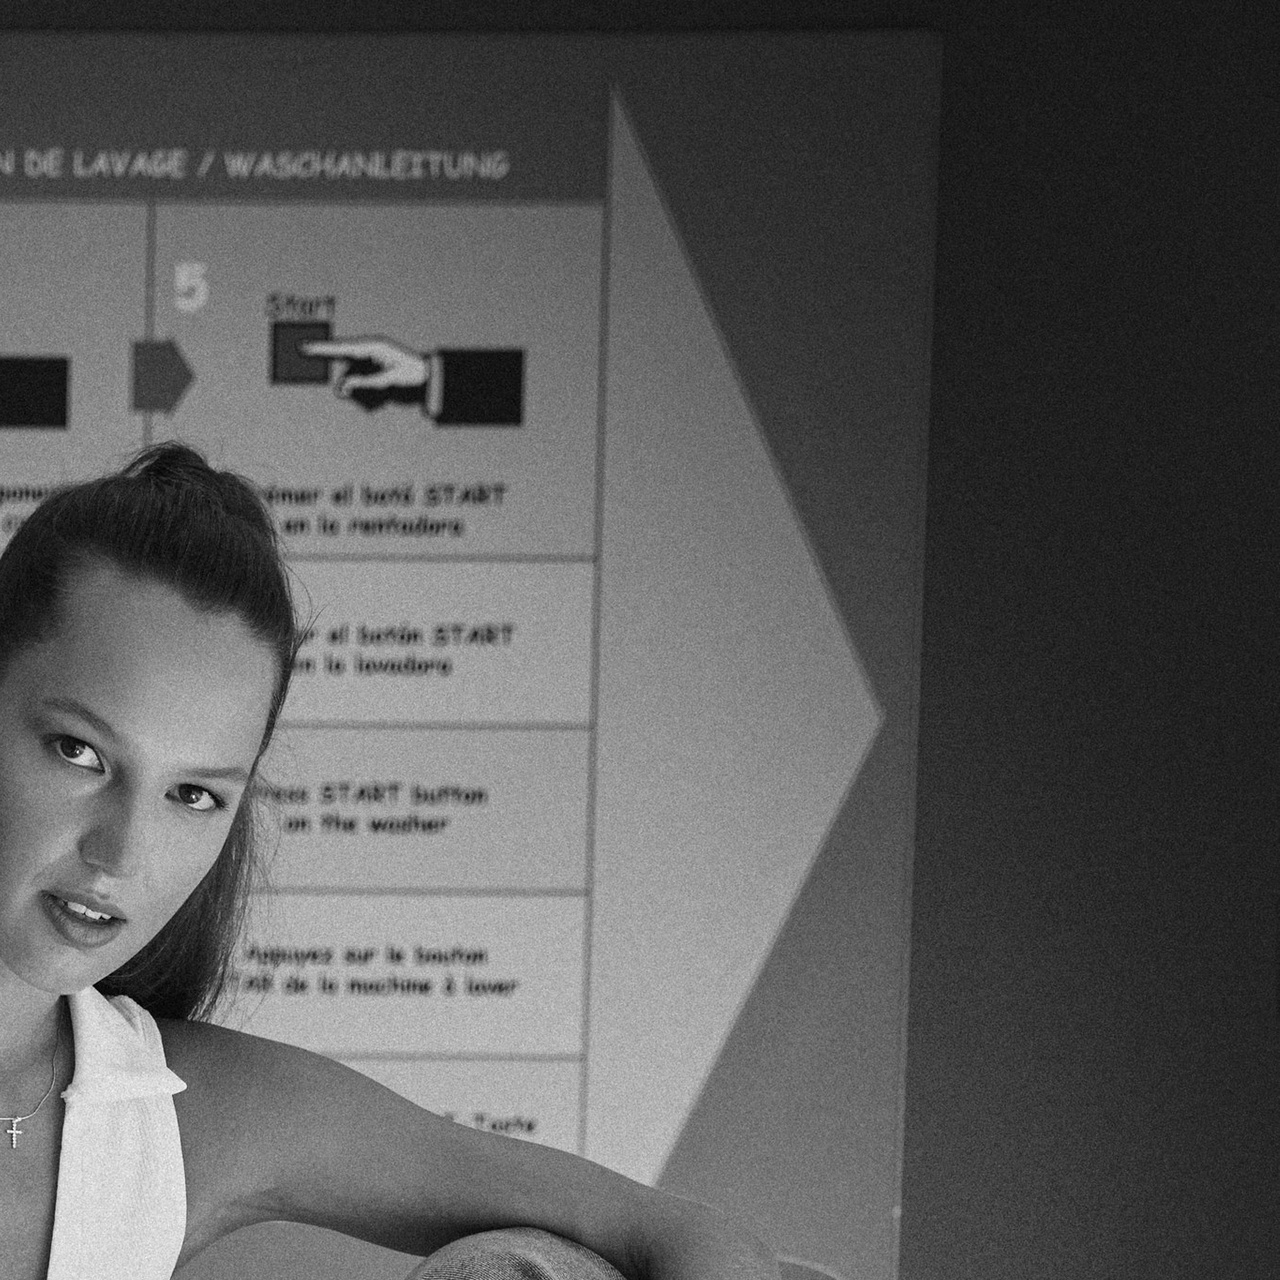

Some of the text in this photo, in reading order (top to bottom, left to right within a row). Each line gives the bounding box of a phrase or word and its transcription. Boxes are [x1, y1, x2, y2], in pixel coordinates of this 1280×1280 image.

[24, 148, 62, 176] DE
[73, 149, 185, 176] LAVAGE
[224, 151, 508, 177] WASCHANLEITUNG
[174, 261, 208, 312] 5
[266, 294, 336, 318] Start
